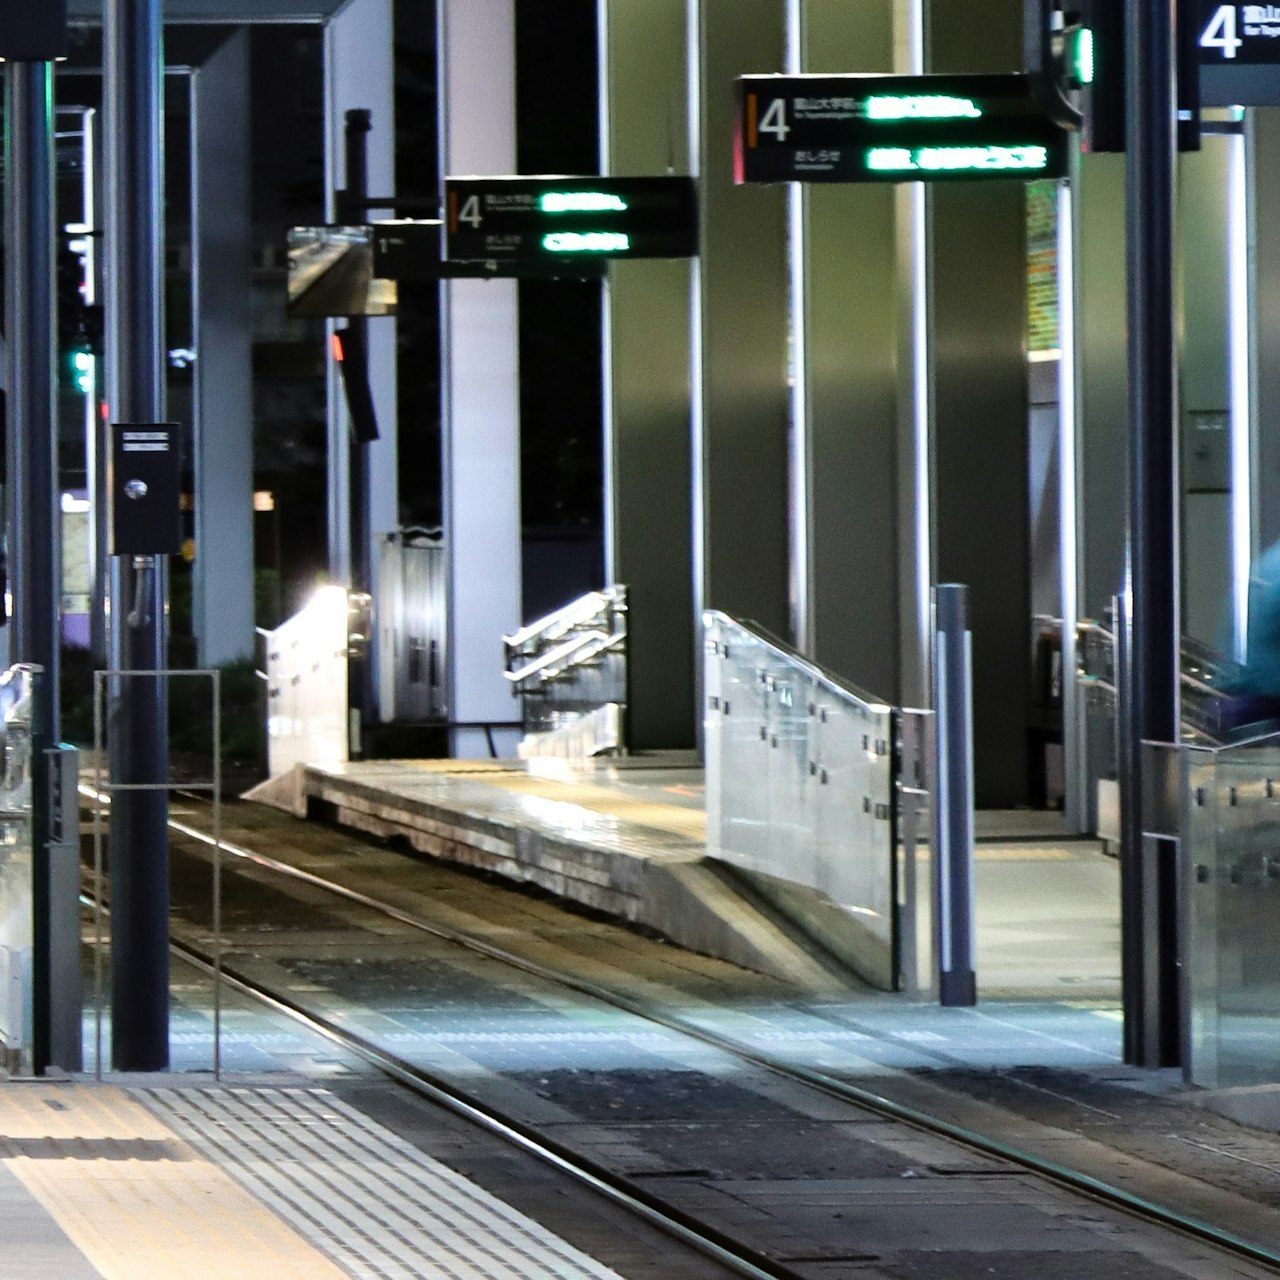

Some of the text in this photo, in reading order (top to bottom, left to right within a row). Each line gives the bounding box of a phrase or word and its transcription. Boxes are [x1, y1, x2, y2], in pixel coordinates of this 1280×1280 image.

[1198, 5, 1243, 58] 4
[758, 97, 791, 142] 4
[458, 194, 483, 228] 4
